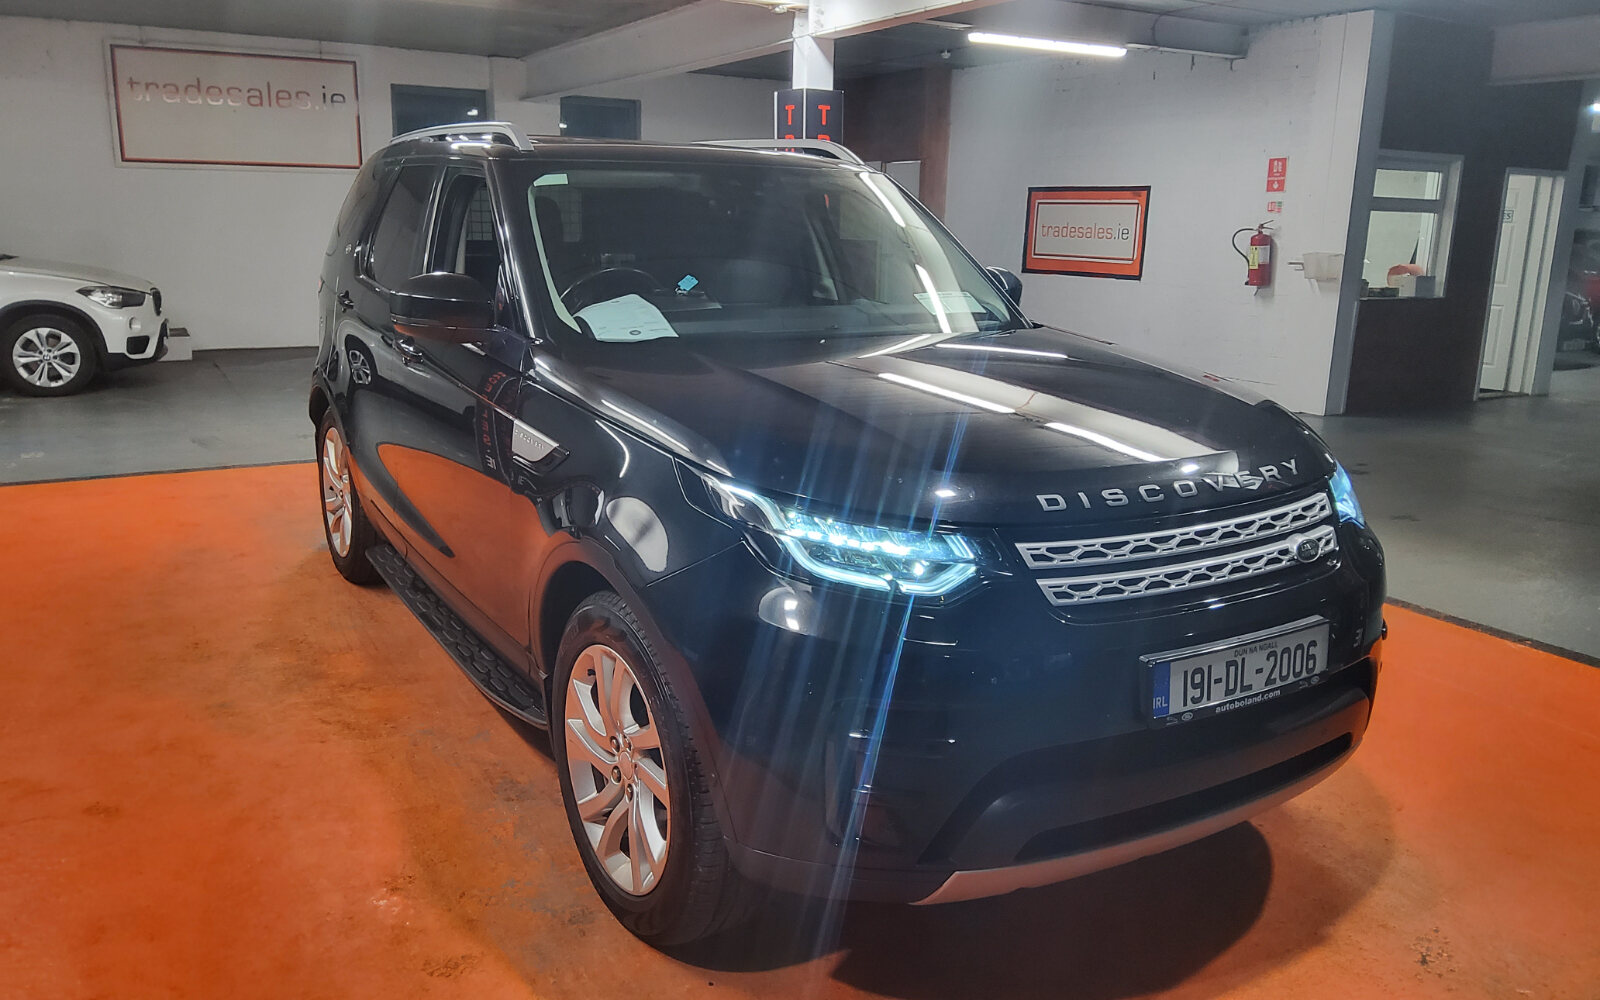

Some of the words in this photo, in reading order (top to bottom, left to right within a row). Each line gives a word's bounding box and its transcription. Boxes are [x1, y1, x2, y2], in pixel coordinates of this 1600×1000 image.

[1041, 223, 1130, 240] tradesales.ie
[1036, 458, 1298, 512] DISCOVERY
[1152, 695, 1168, 710] IRL
[1215, 689, 1281, 714] autoboland.com
